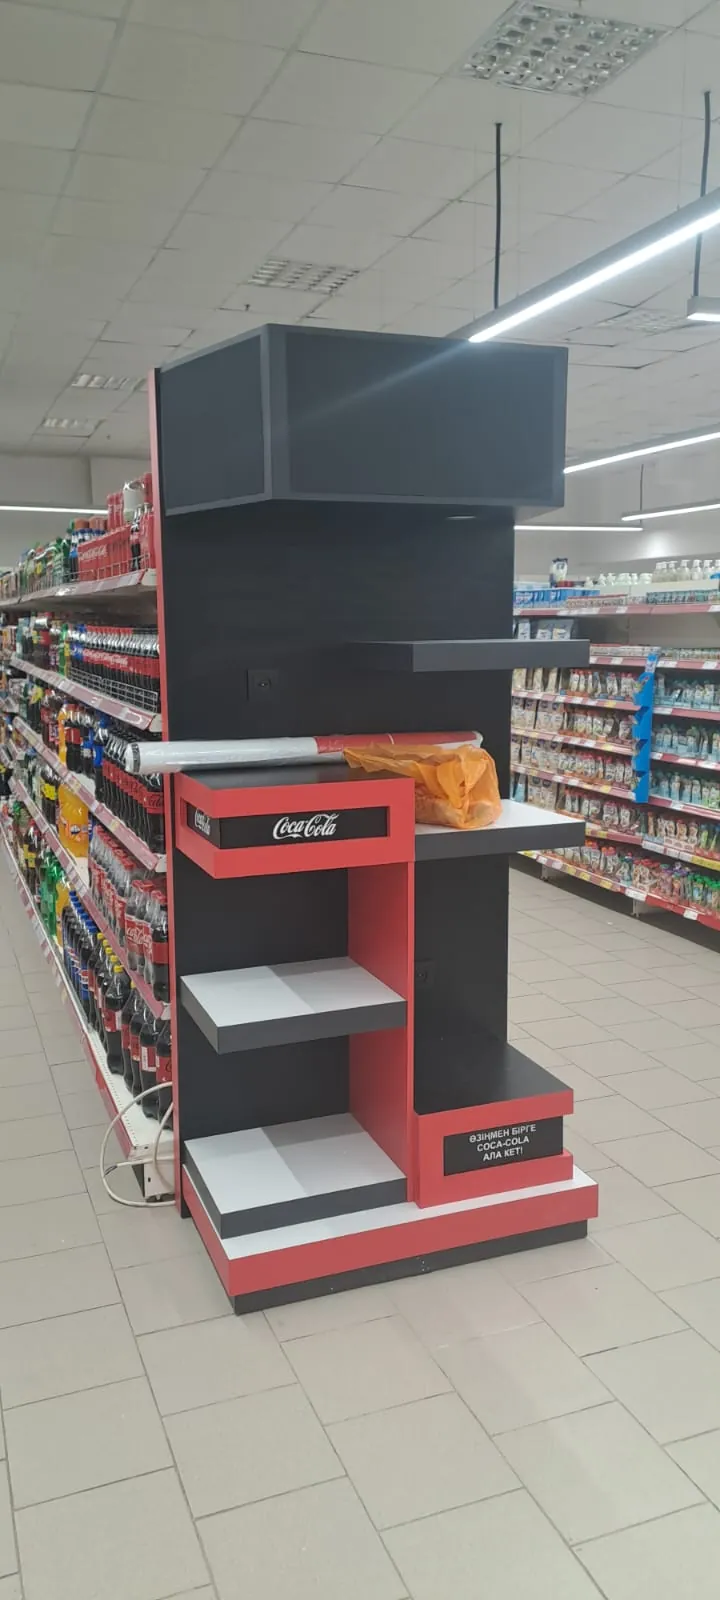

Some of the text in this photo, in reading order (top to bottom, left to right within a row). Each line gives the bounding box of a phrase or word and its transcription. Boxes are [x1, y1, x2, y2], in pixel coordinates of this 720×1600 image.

[273, 813, 339, 840] Coca-Cola
[512, 1124, 536, 1135] БІРГЕ
[477, 1135, 530, 1152] COCA-COLA
[483, 1146, 523, 1161] АЛА КЕТ!
